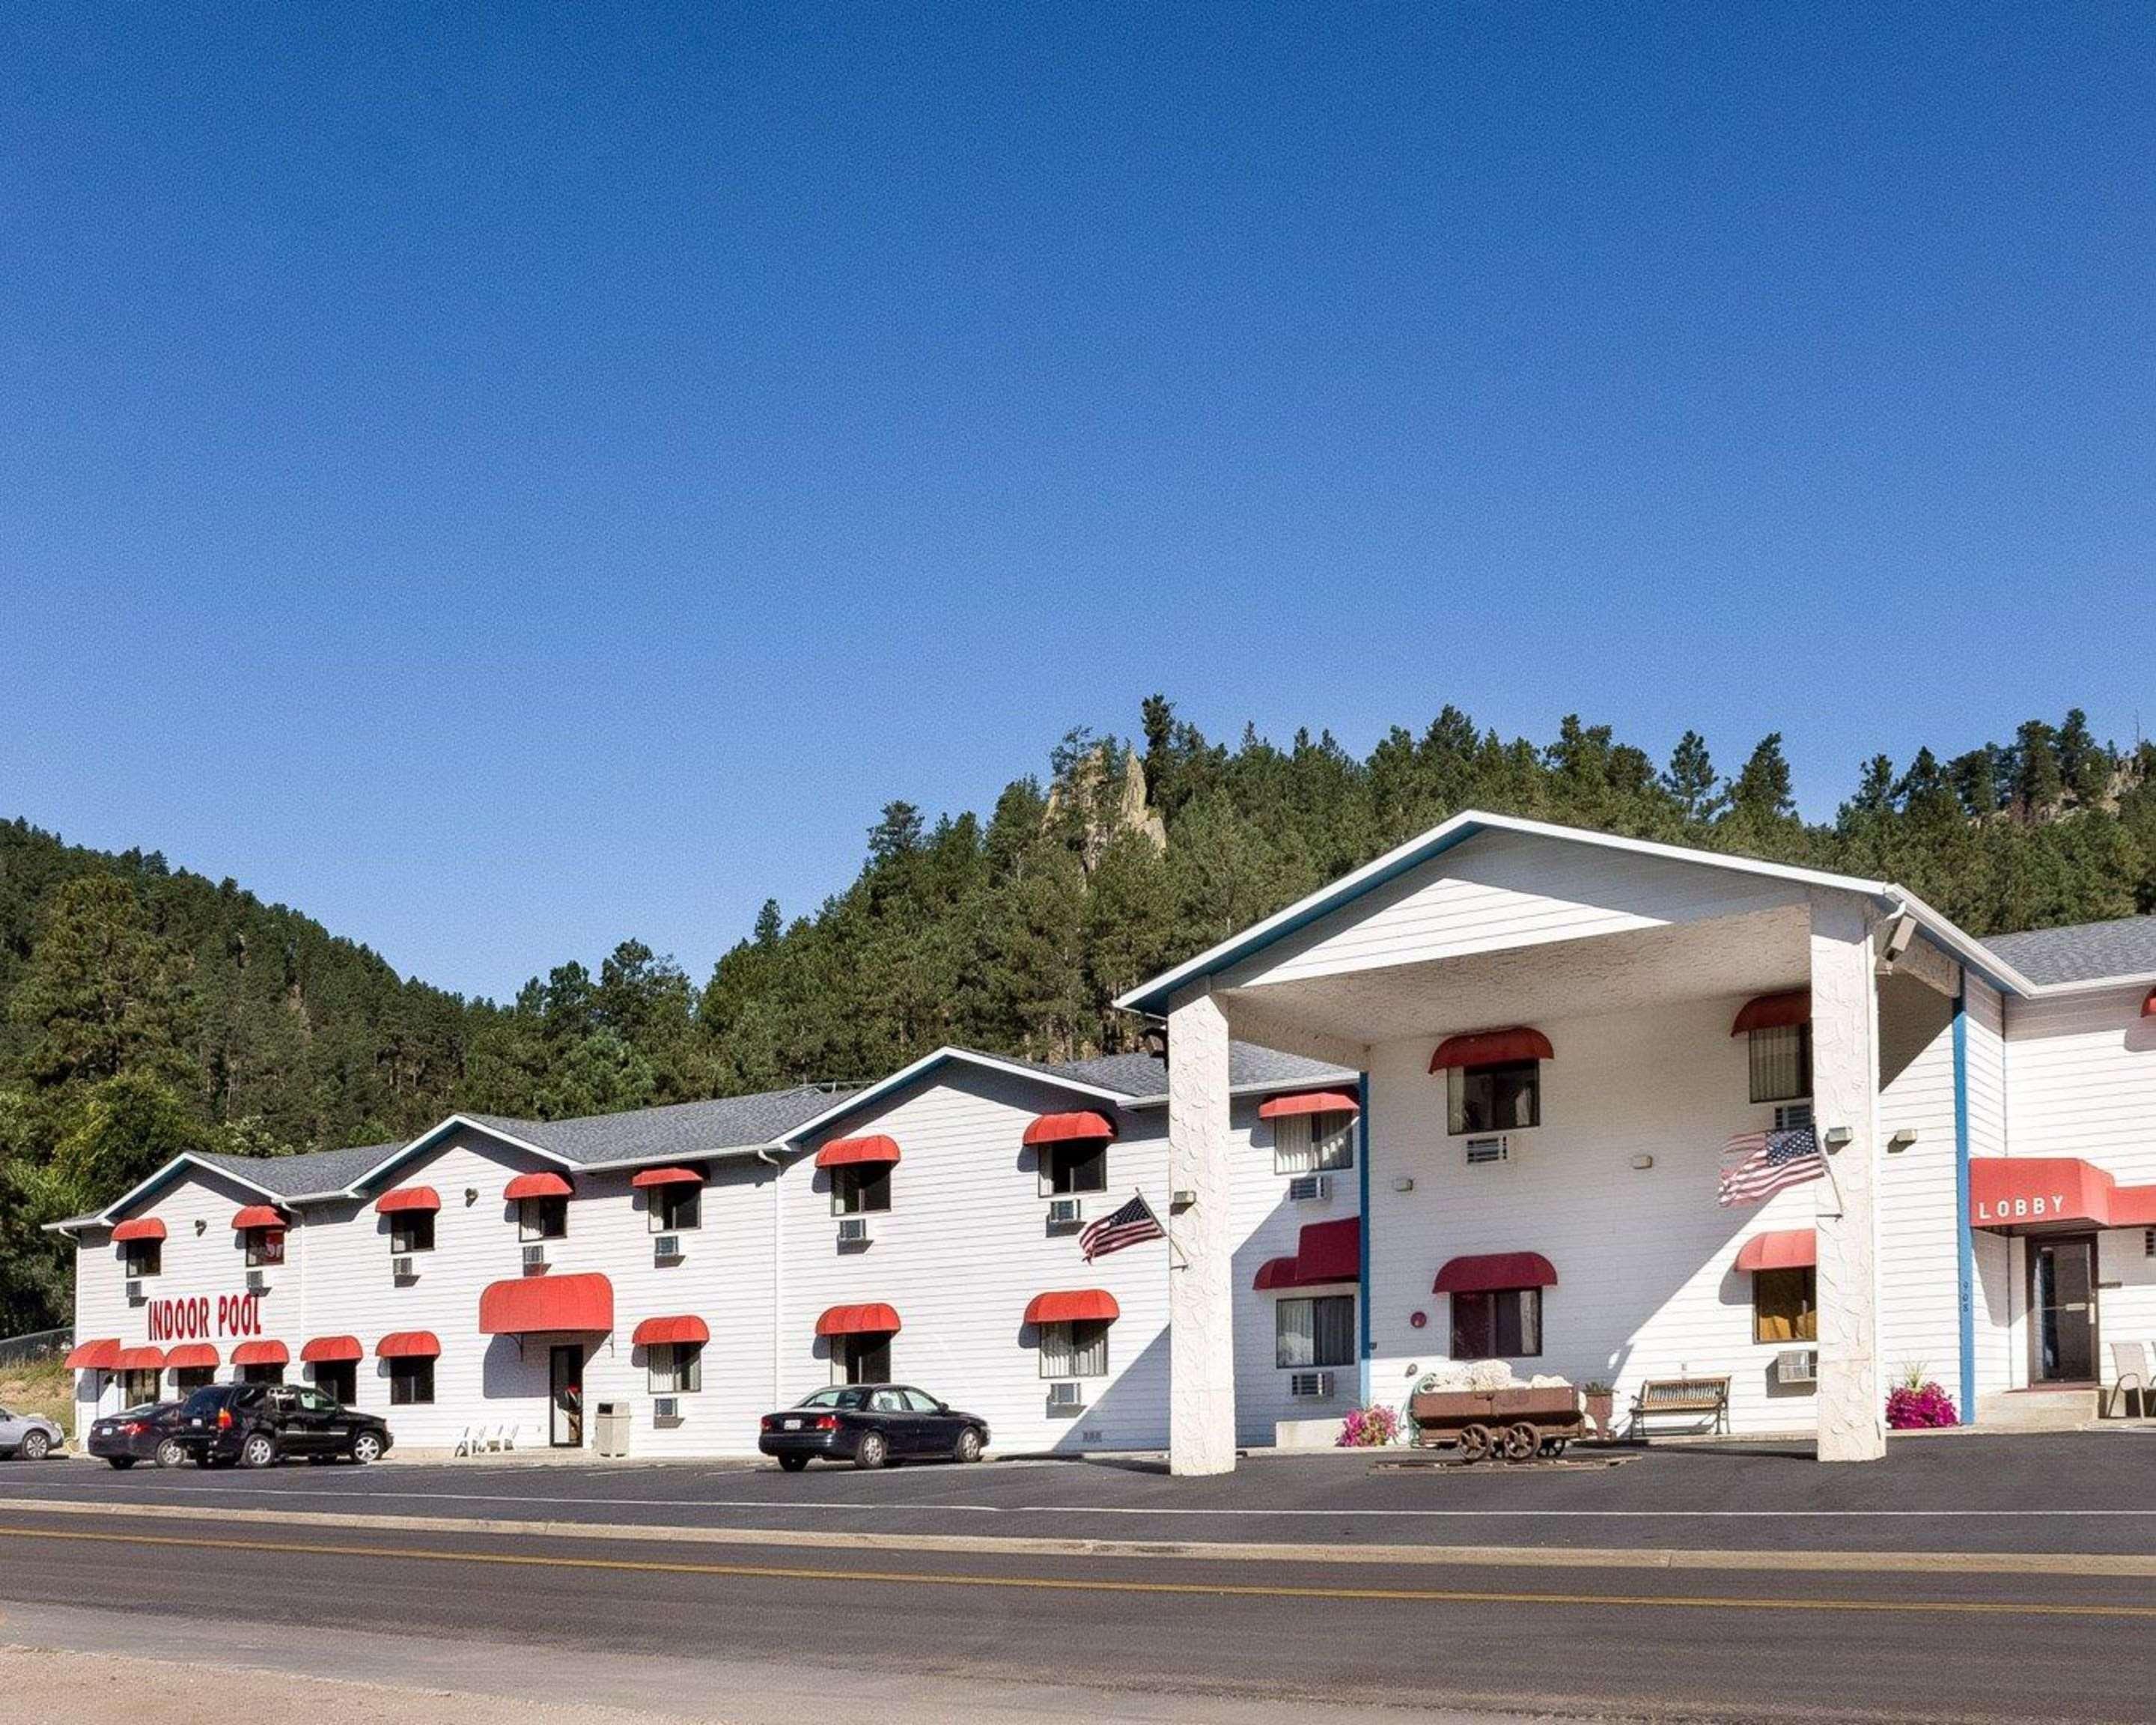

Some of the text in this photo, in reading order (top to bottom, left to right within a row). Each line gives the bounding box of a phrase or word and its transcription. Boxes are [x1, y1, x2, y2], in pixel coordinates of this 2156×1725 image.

[1979, 1195, 2064, 1220] LOBBY
[148, 1293, 261, 1341] INDOOR POOL
